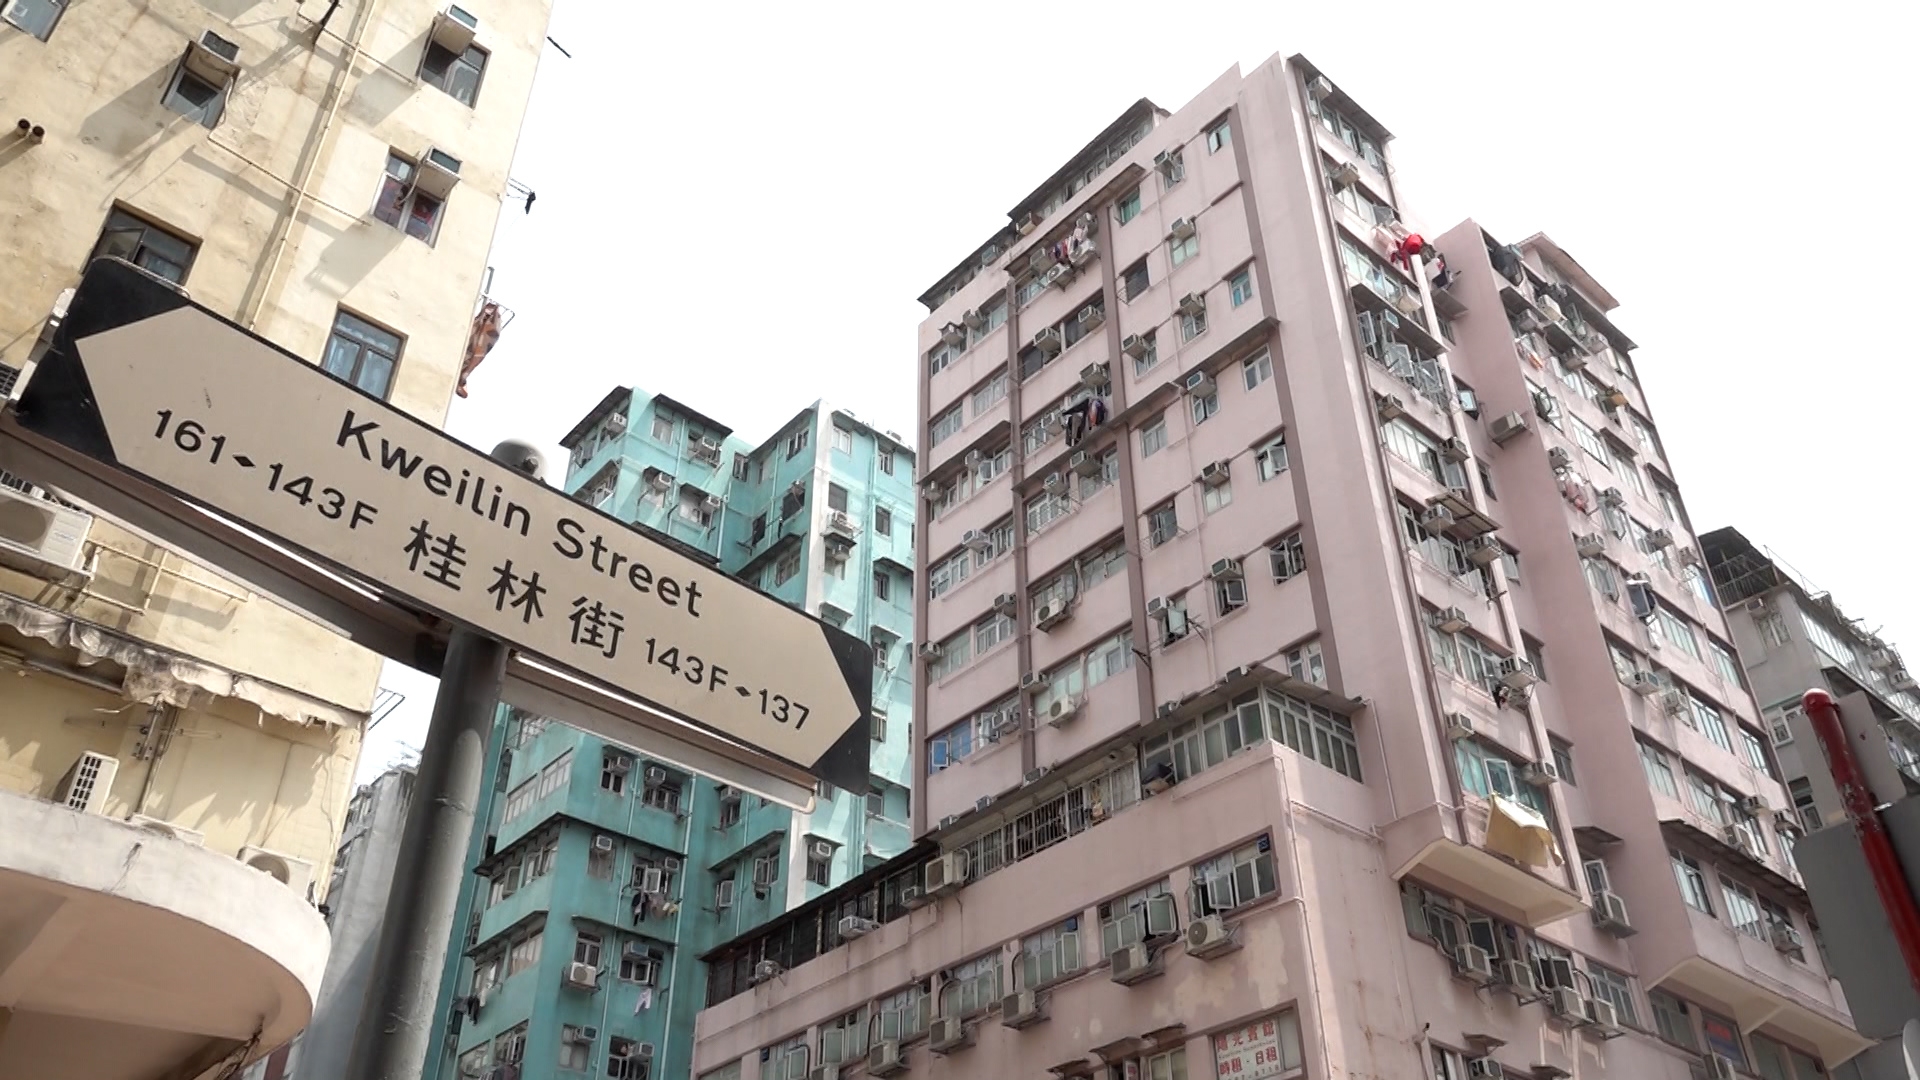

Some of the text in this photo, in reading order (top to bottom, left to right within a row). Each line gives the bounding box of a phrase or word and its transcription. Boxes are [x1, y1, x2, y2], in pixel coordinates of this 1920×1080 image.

[154, 409, 379, 530] 161 143F
[336, 409, 703, 619] Kweilin Street
[403, 518, 625, 660] 桂林街
[645, 637, 810, 731] 143F 137
